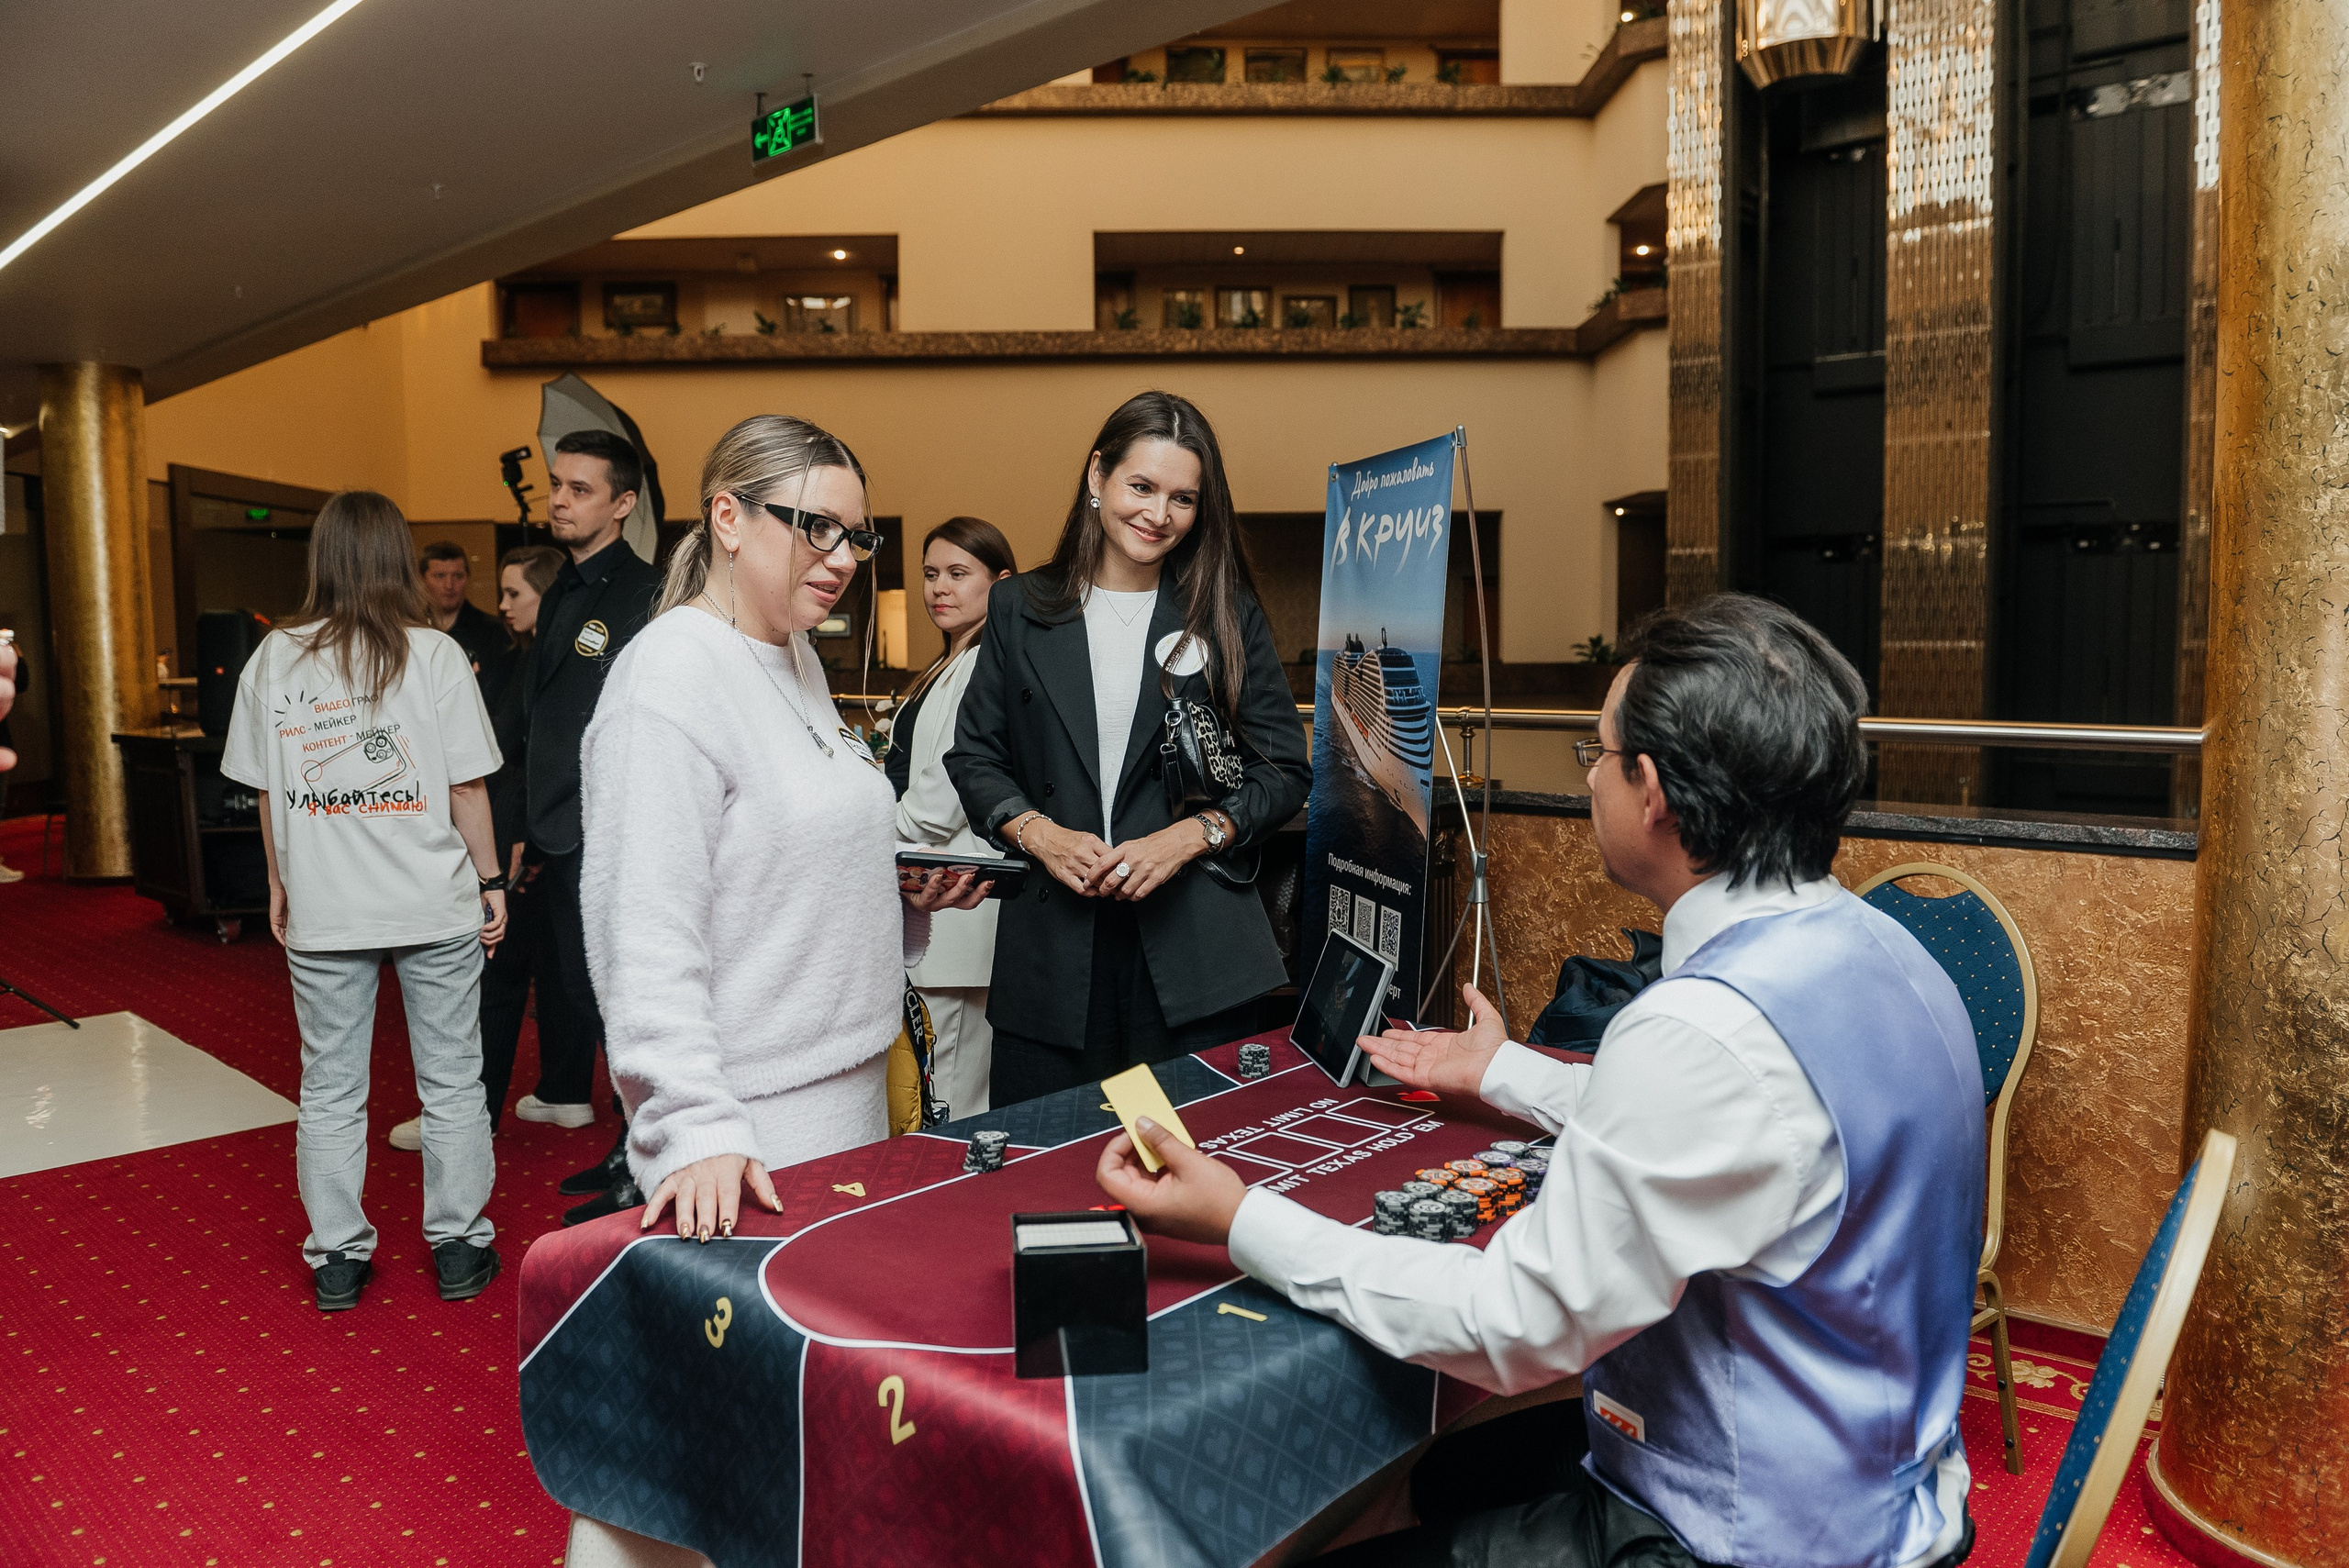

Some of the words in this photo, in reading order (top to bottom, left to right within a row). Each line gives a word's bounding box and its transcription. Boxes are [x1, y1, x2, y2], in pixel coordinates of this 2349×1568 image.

[1351, 471, 1378, 501] Добро
[1380, 456, 1434, 489] пожаловать
[314, 715, 357, 732] МЕЙКЕР
[302, 735, 347, 752] КОНТЕНТ
[355, 724, 401, 741] МЕЙКЕР
[1328, 852, 1364, 877] Подробная
[1364, 869, 1412, 896] информация:
[1386, 984, 1401, 1000] ерт
[1308, 1097, 1340, 1109] NO
[1262, 1107, 1314, 1128] LIMIT
[1197, 1125, 1265, 1151] TEXAS
[1306, 1150, 1373, 1177] TEXAS
[831, 1181, 867, 1198] 4
[704, 1296, 733, 1349] 3
[1217, 1302, 1268, 1322] 1
[876, 1374, 917, 1445] 2
